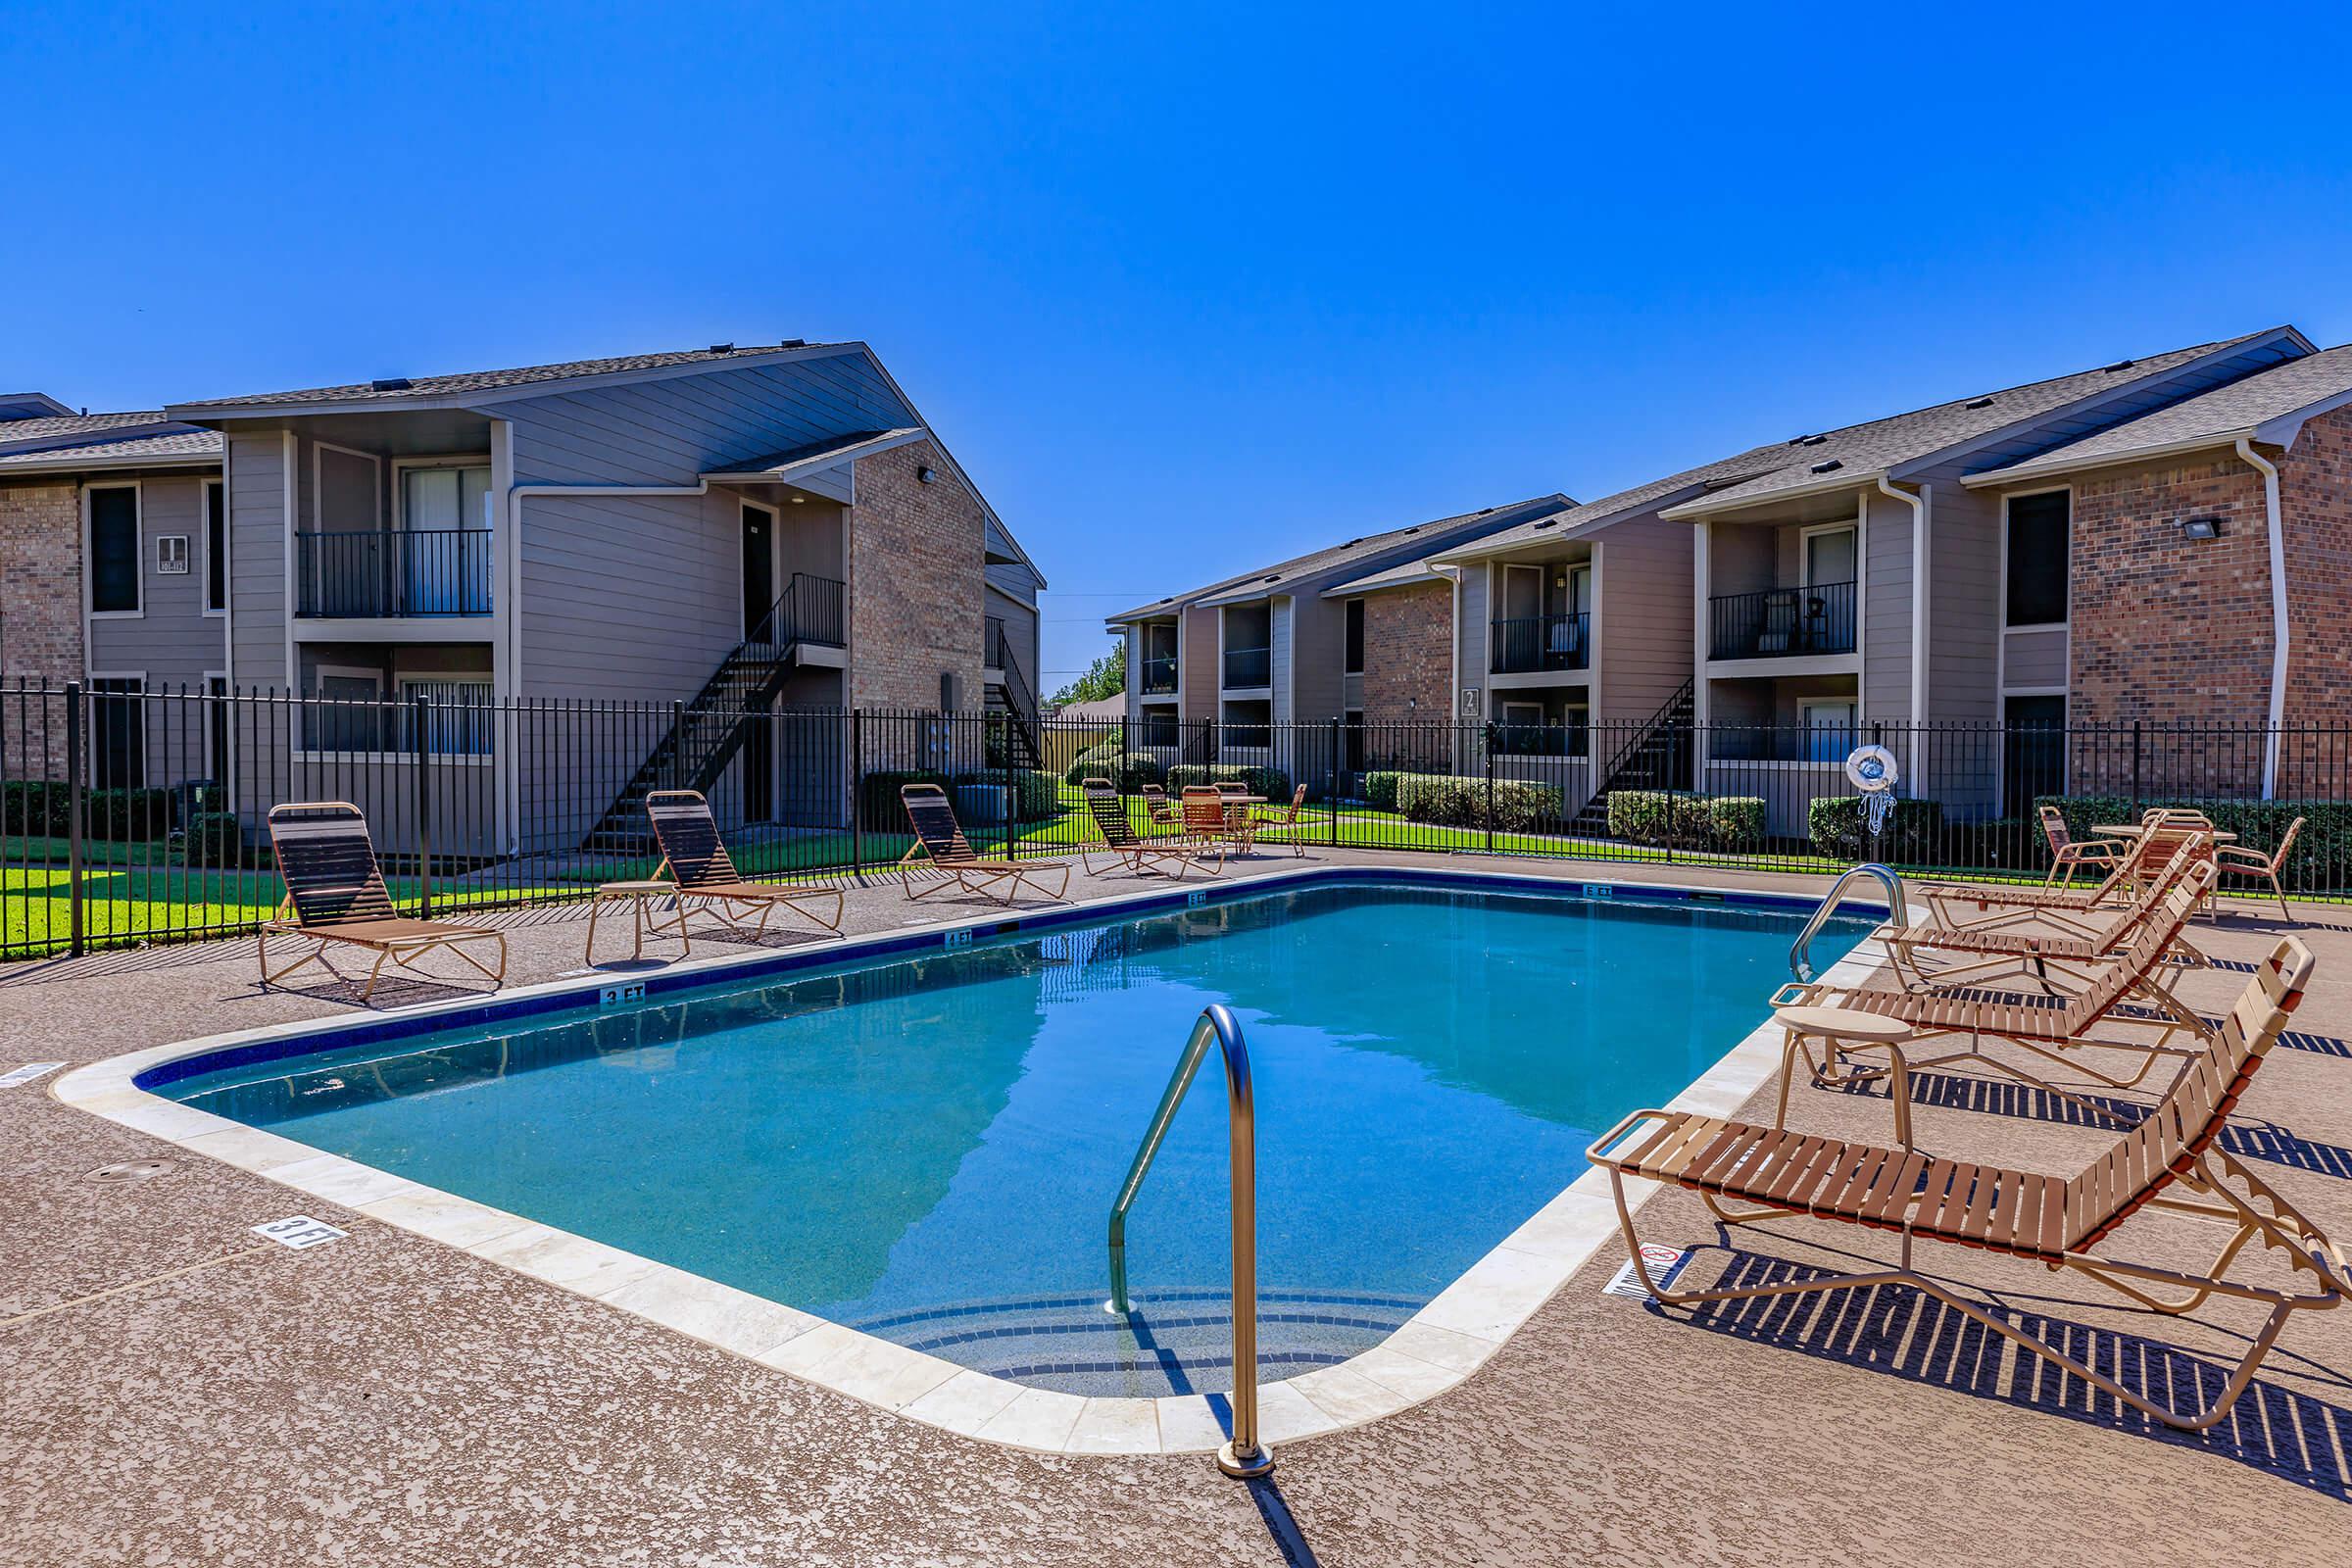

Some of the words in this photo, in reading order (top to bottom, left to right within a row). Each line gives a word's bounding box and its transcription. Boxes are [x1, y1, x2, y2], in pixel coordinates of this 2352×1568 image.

[1466, 691, 1474, 708] 2
[607, 990, 617, 1005] 3
[267, 1219, 309, 1233] 3
[283, 1226, 343, 1246] FT
